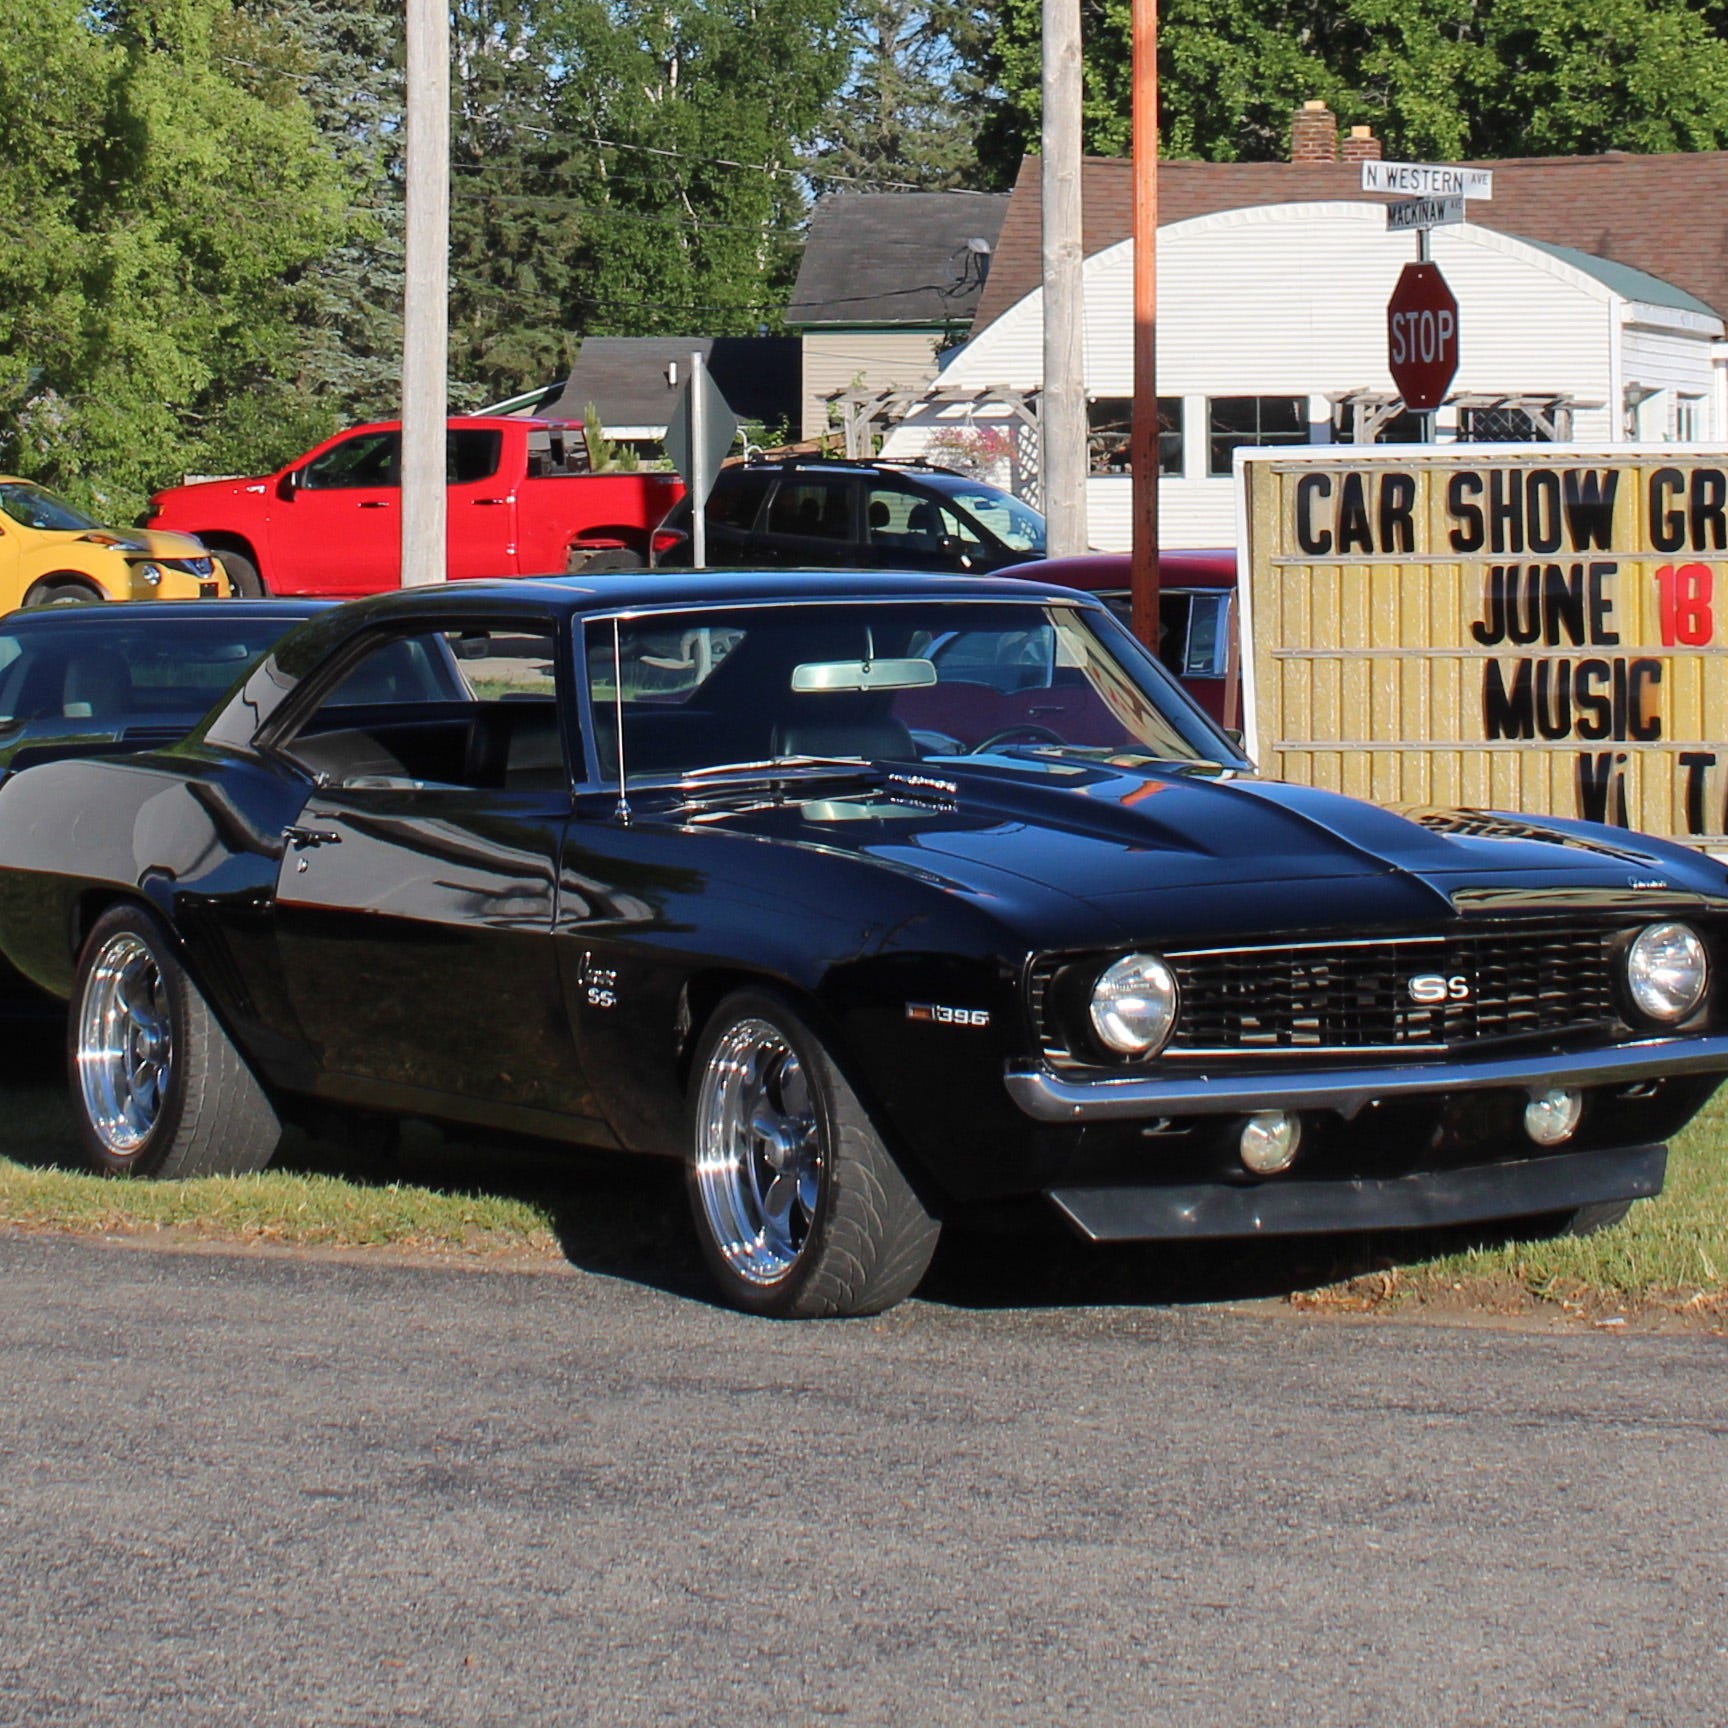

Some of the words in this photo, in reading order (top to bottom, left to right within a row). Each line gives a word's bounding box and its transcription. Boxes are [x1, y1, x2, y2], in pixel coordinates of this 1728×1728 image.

[1367, 165, 1378, 187] N
[1386, 166, 1463, 193] WESTERN
[1471, 173, 1488, 186] AVE
[1387, 199, 1446, 227] MACKINAW
[1451, 198, 1463, 210] AVE
[1392, 309, 1454, 365] STOP
[1297, 472, 1415, 554] CAR
[1448, 468, 1619, 554] SHOW
[1471, 562, 1619, 647] JUNE
[1655, 563, 1713, 647] 18
[1482, 657, 1662, 742] MUSIC
[588, 987, 617, 1008] SS
[1408, 974, 1469, 1003] SS
[936, 1005, 990, 1026] 396
